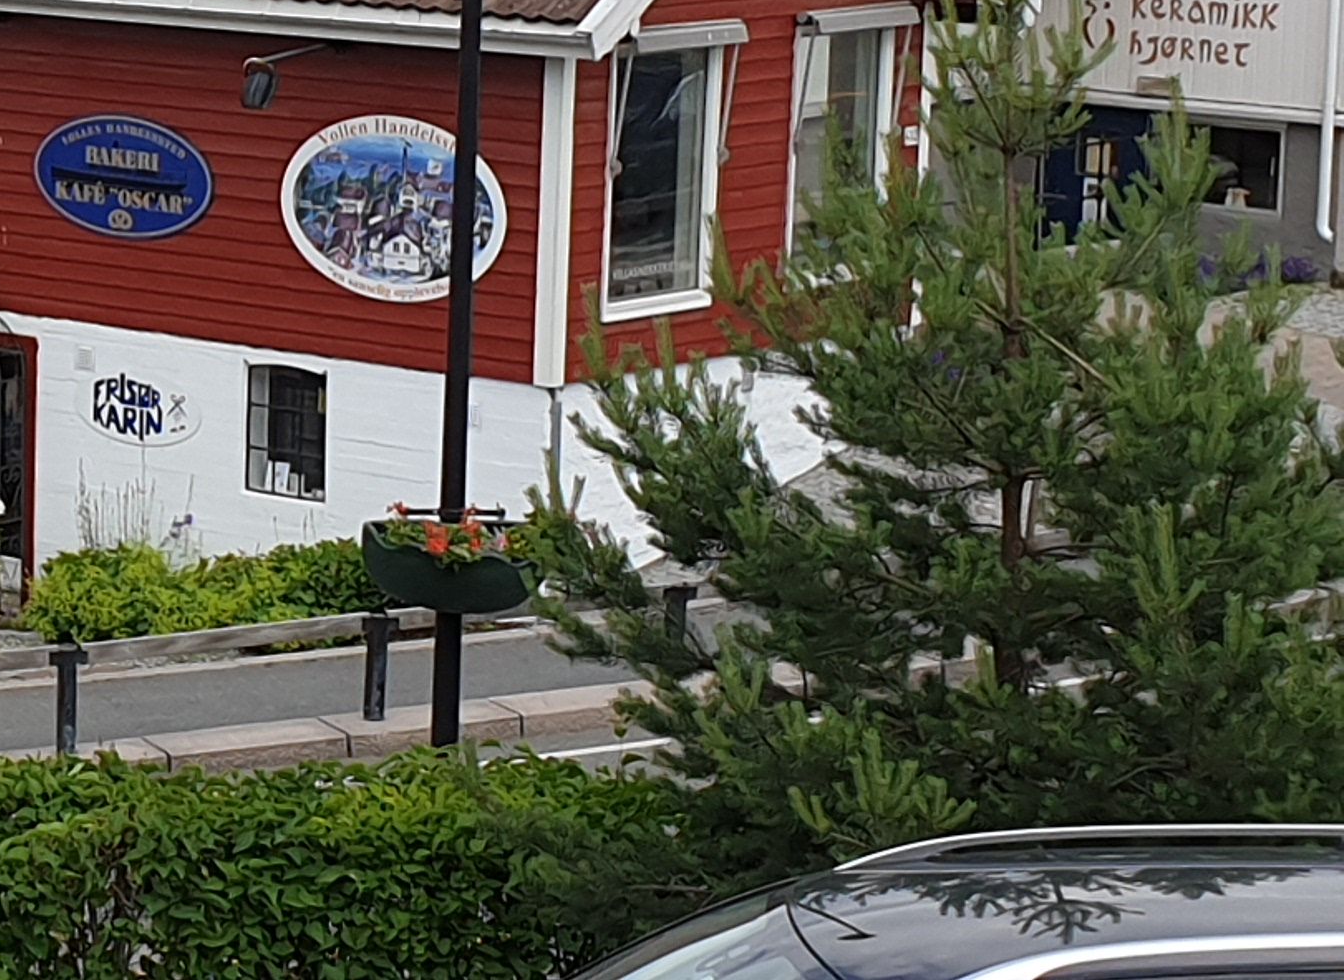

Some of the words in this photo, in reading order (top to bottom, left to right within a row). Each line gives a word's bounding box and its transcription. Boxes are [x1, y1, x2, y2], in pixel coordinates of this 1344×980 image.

[318, 123, 368, 145] Vollen
[85, 144, 160, 172] BAKERI
[94, 373, 161, 408] FRISØR
[93, 403, 163, 441] KARIN
